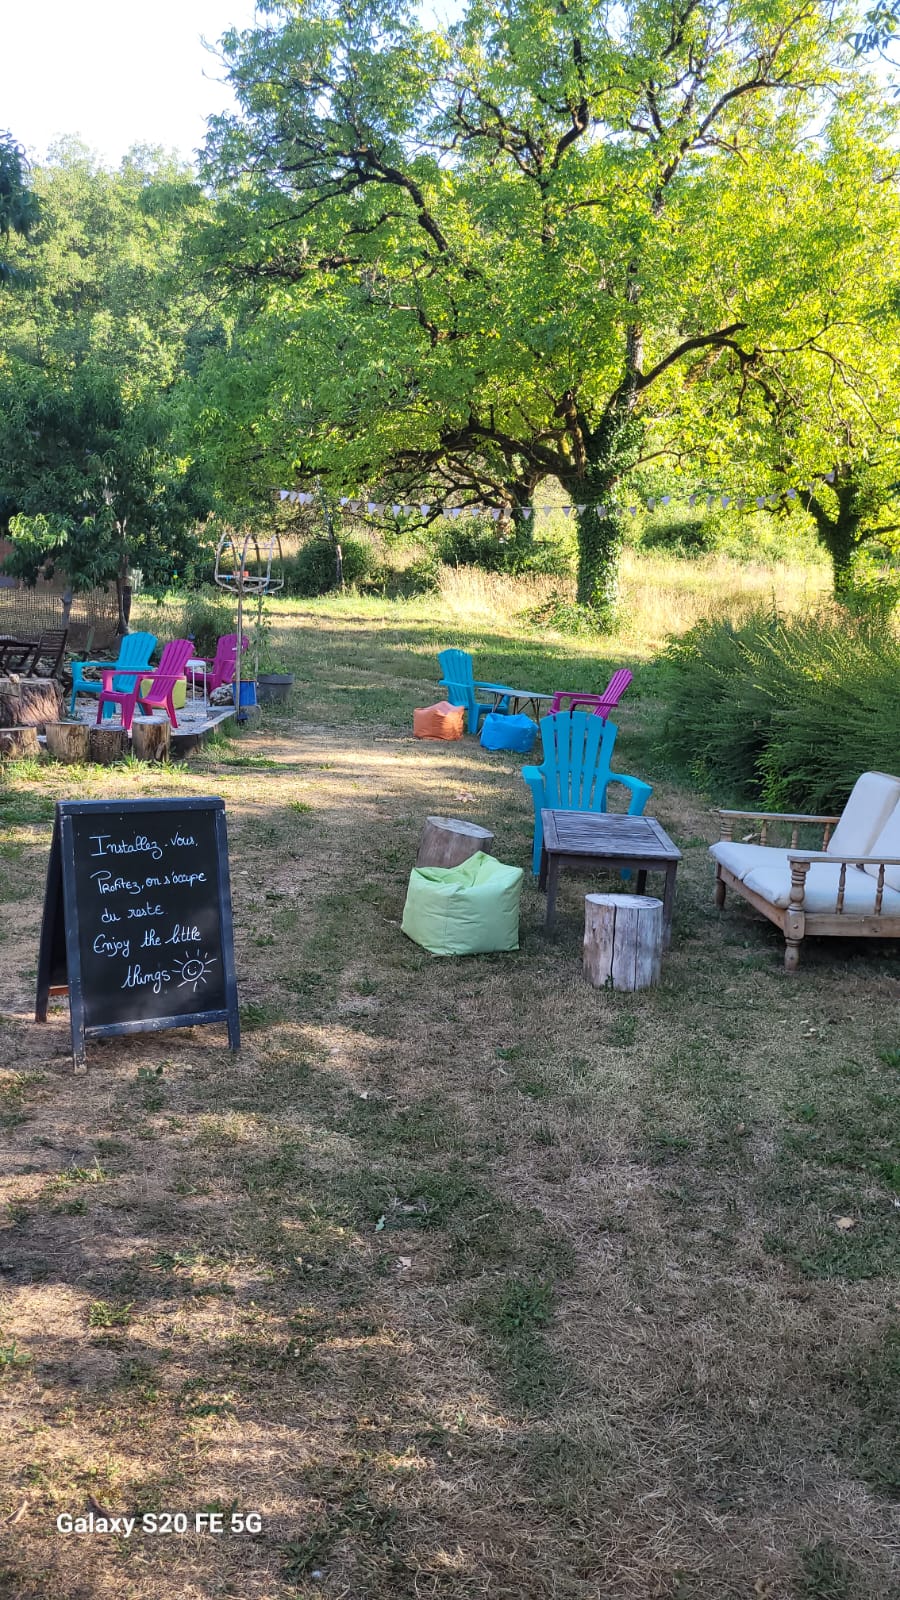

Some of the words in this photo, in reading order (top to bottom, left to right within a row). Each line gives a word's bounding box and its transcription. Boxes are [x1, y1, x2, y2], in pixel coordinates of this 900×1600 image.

[145, 877, 162, 887] on
[100, 907, 120, 922] du
[93, 934, 130, 957] Enjoy
[141, 929, 161, 947] the
[165, 924, 201, 944] little
